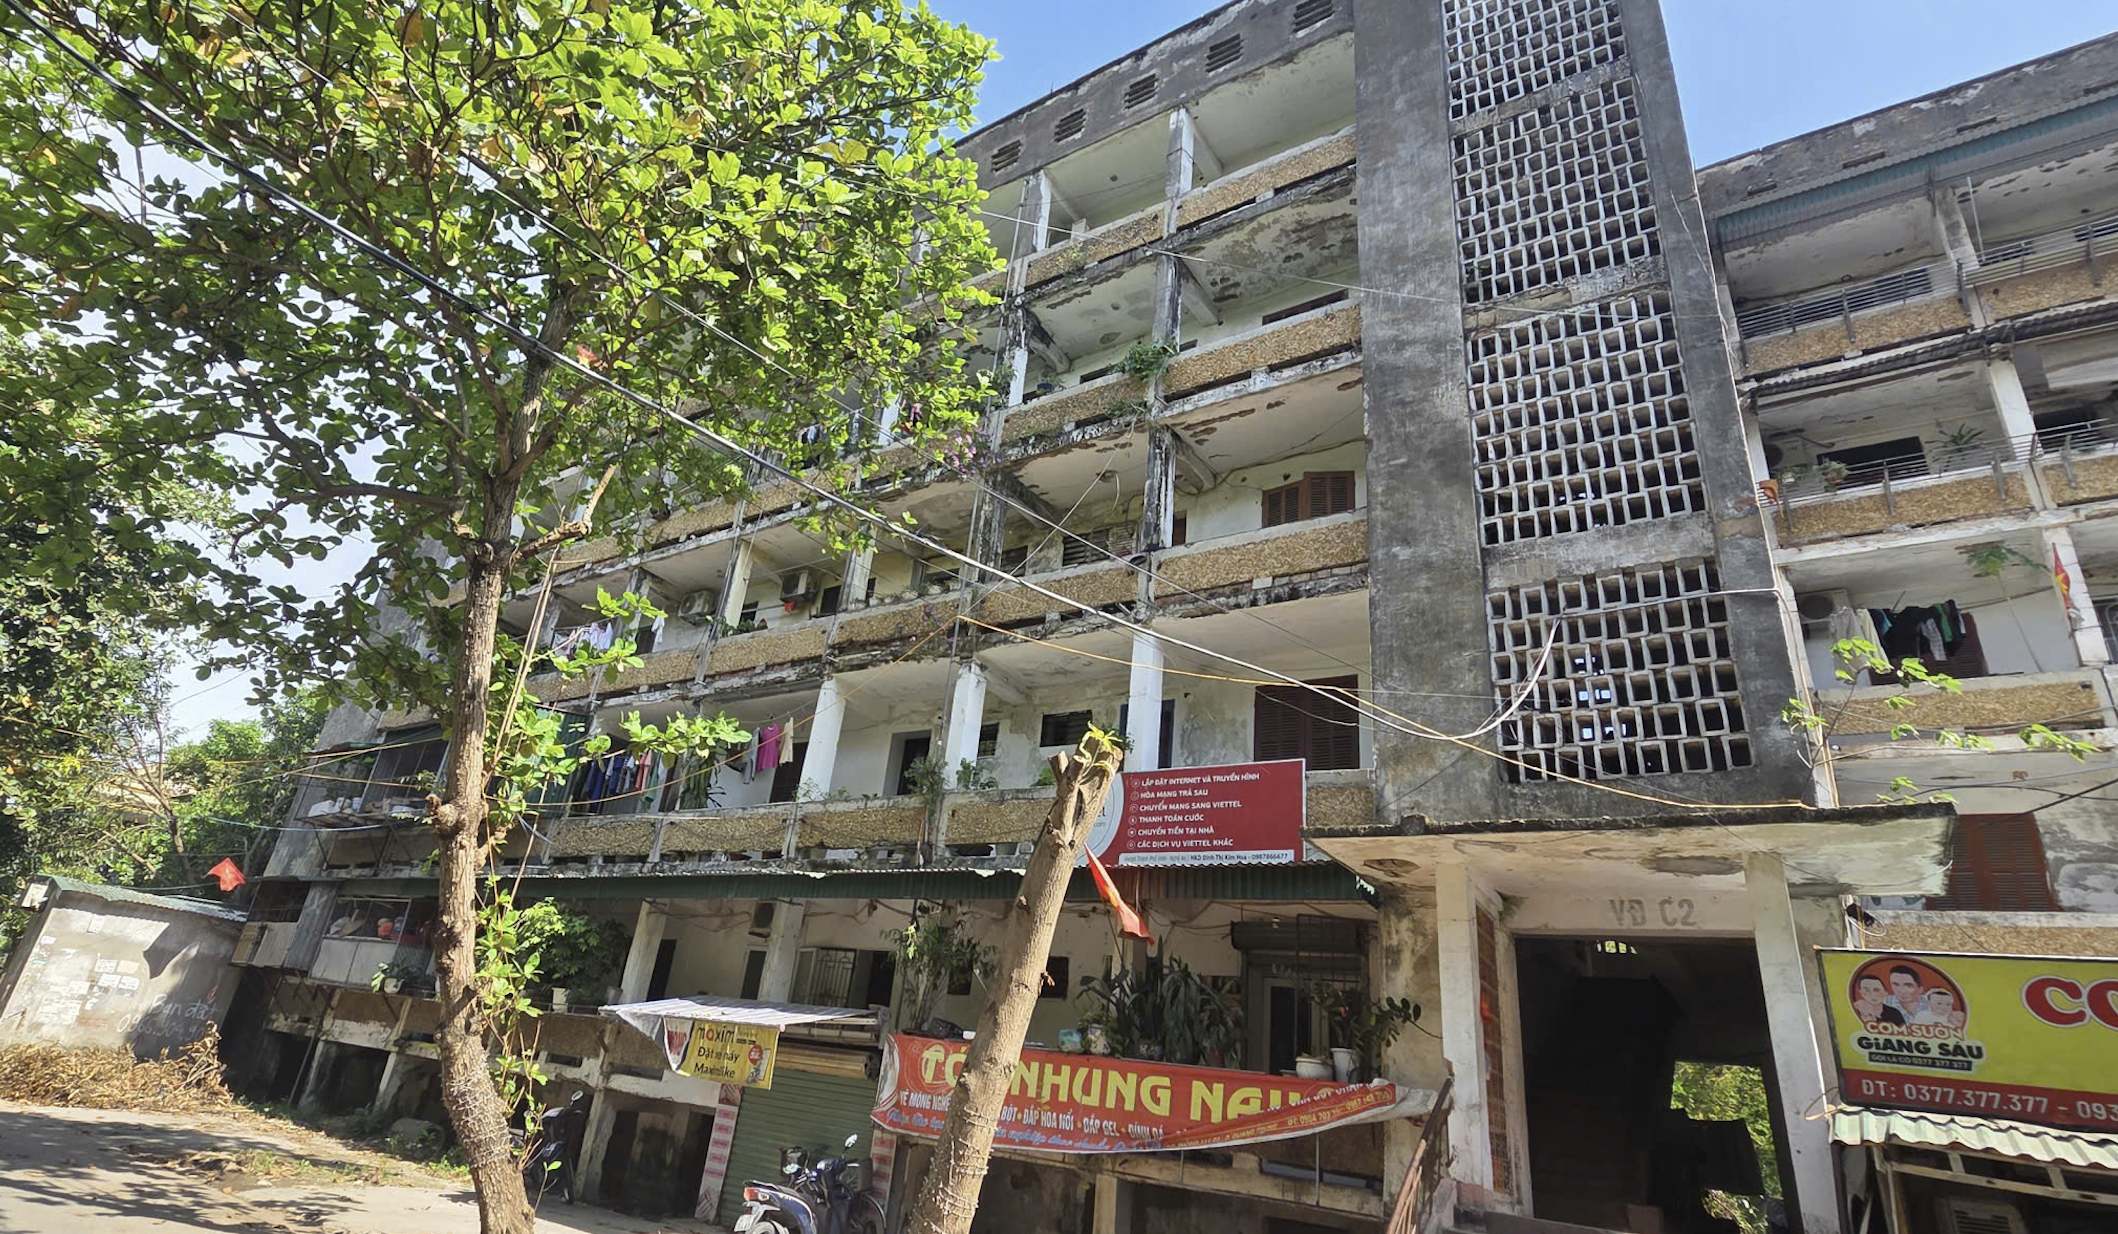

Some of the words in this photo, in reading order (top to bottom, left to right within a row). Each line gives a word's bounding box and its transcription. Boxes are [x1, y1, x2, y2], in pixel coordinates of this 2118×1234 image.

[1169, 776, 1201, 785] INTERNET
[1202, 774, 1212, 784] VÀ
[1140, 790, 1155, 799] HÒA
[1156, 789, 1177, 800] MẠNG
[1193, 788, 1208, 796] SAU
[1169, 802, 1190, 812] MẠNG
[1191, 802, 1211, 810] SANG
[1212, 800, 1242, 808] VIETTEL
[1138, 815, 1163, 823] THANH
[1163, 813, 1183, 822] TOÁN
[1186, 827, 1198, 836] TẠI
[1198, 825, 1214, 834] NHÀ
[1137, 838, 1153, 848] CÁC
[1153, 840, 1170, 849] DỊCH
[1170, 840, 1182, 849] VỤ
[1182, 838, 1212, 847] VIETTEL
[1212, 837, 1233, 847] KHÁC
[1225, 853, 1236, 861] Kim
[1658, 898, 1697, 926] C2
[697, 1022, 734, 1045] maxim
[1866, 1021, 1908, 1037] CƠM
[1909, 1019, 1964, 1040] SƯỜN
[1937, 1040, 1983, 1060] SÁU
[1010, 1061, 1172, 1118] NHUNG
[1861, 1079, 1896, 1098] ĐT:
[1903, 1083, 2048, 1113] 0377.377.377
[910, 1092, 931, 1111] MÓNG
[1040, 1111, 1059, 1129] HOA
[1101, 1120, 1120, 1137] GEL
